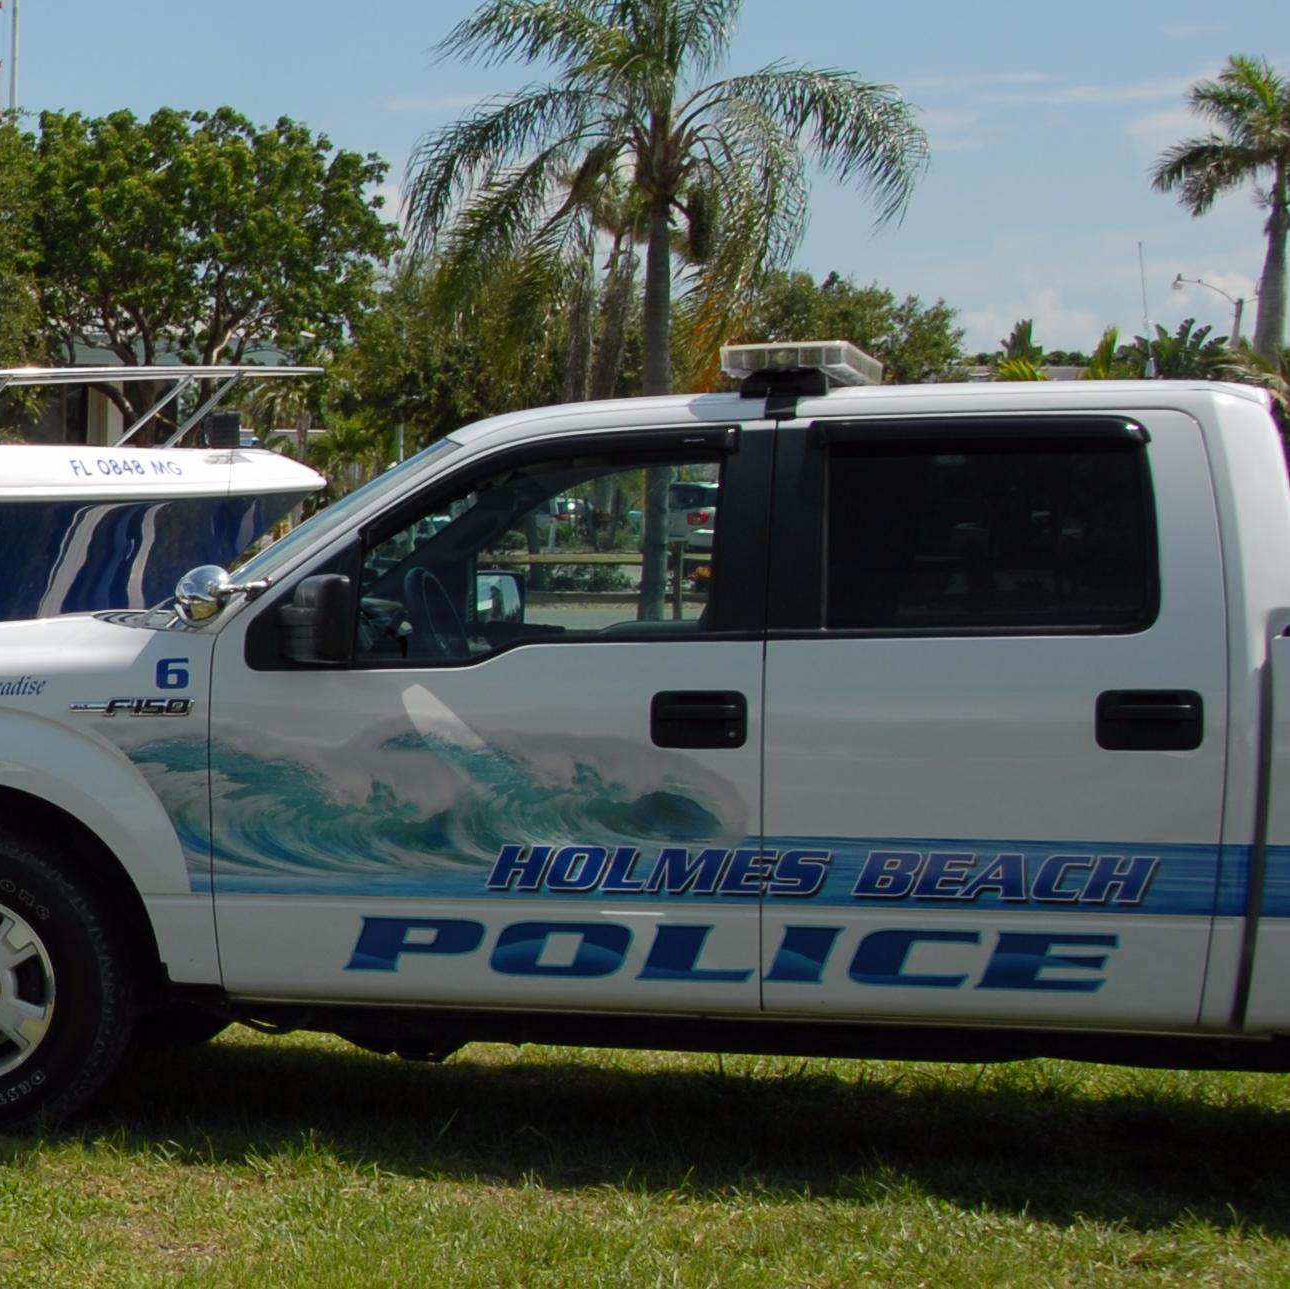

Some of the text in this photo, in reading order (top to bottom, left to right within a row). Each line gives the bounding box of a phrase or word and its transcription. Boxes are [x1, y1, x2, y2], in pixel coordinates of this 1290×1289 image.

[70, 459, 183, 476] FL 0848 MG
[156, 657, 189, 689] 6
[487, 844, 1161, 906] HOLMES BEACH
[343, 915, 1120, 993] POLICE
